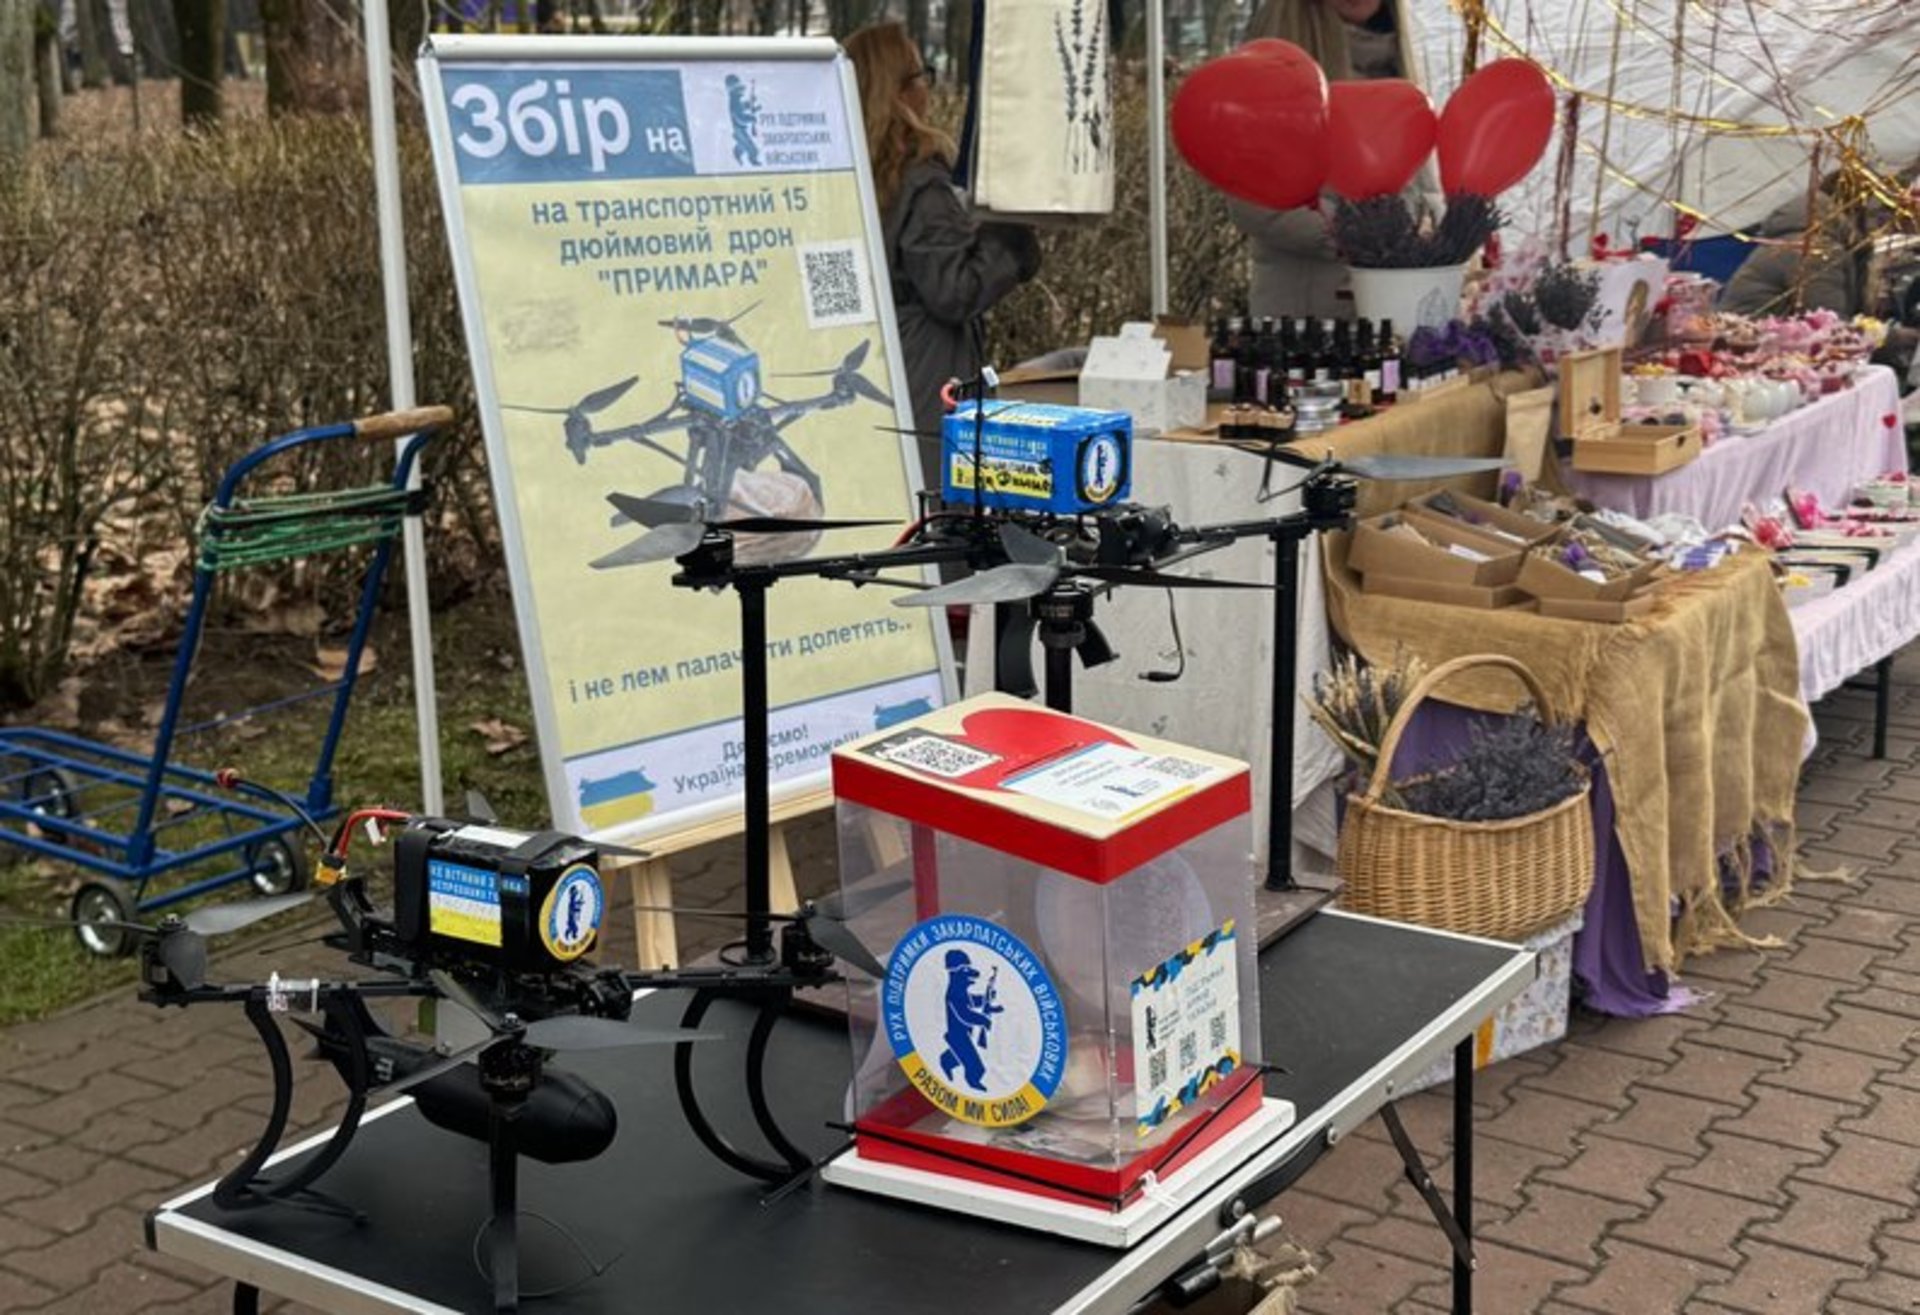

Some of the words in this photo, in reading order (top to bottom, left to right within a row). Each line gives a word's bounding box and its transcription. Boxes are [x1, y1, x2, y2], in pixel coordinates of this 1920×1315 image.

[451, 79, 630, 172] Збір
[646, 125, 687, 154] на
[532, 201, 569, 225] на
[576, 188, 775, 228] транспортний
[781, 187, 808, 216] 15
[560, 226, 712, 266] дюймовий
[728, 226, 795, 257] дрон
[598, 258, 768, 296] "ПРИМАРА"
[570, 680, 578, 704] і
[586, 678, 614, 701] не
[621, 666, 670, 693] лем
[887, 932, 930, 1004] ПІДТРИМКИ
[931, 921, 1038, 980] ЗАКАРПАТСЬКИХ
[890, 1012, 906, 1041] РУХ
[1034, 983, 1063, 1082] ВІЙСЬКОВИХ
[914, 1067, 959, 1112] РАЗОМ
[964, 1099, 985, 1121] МИ
